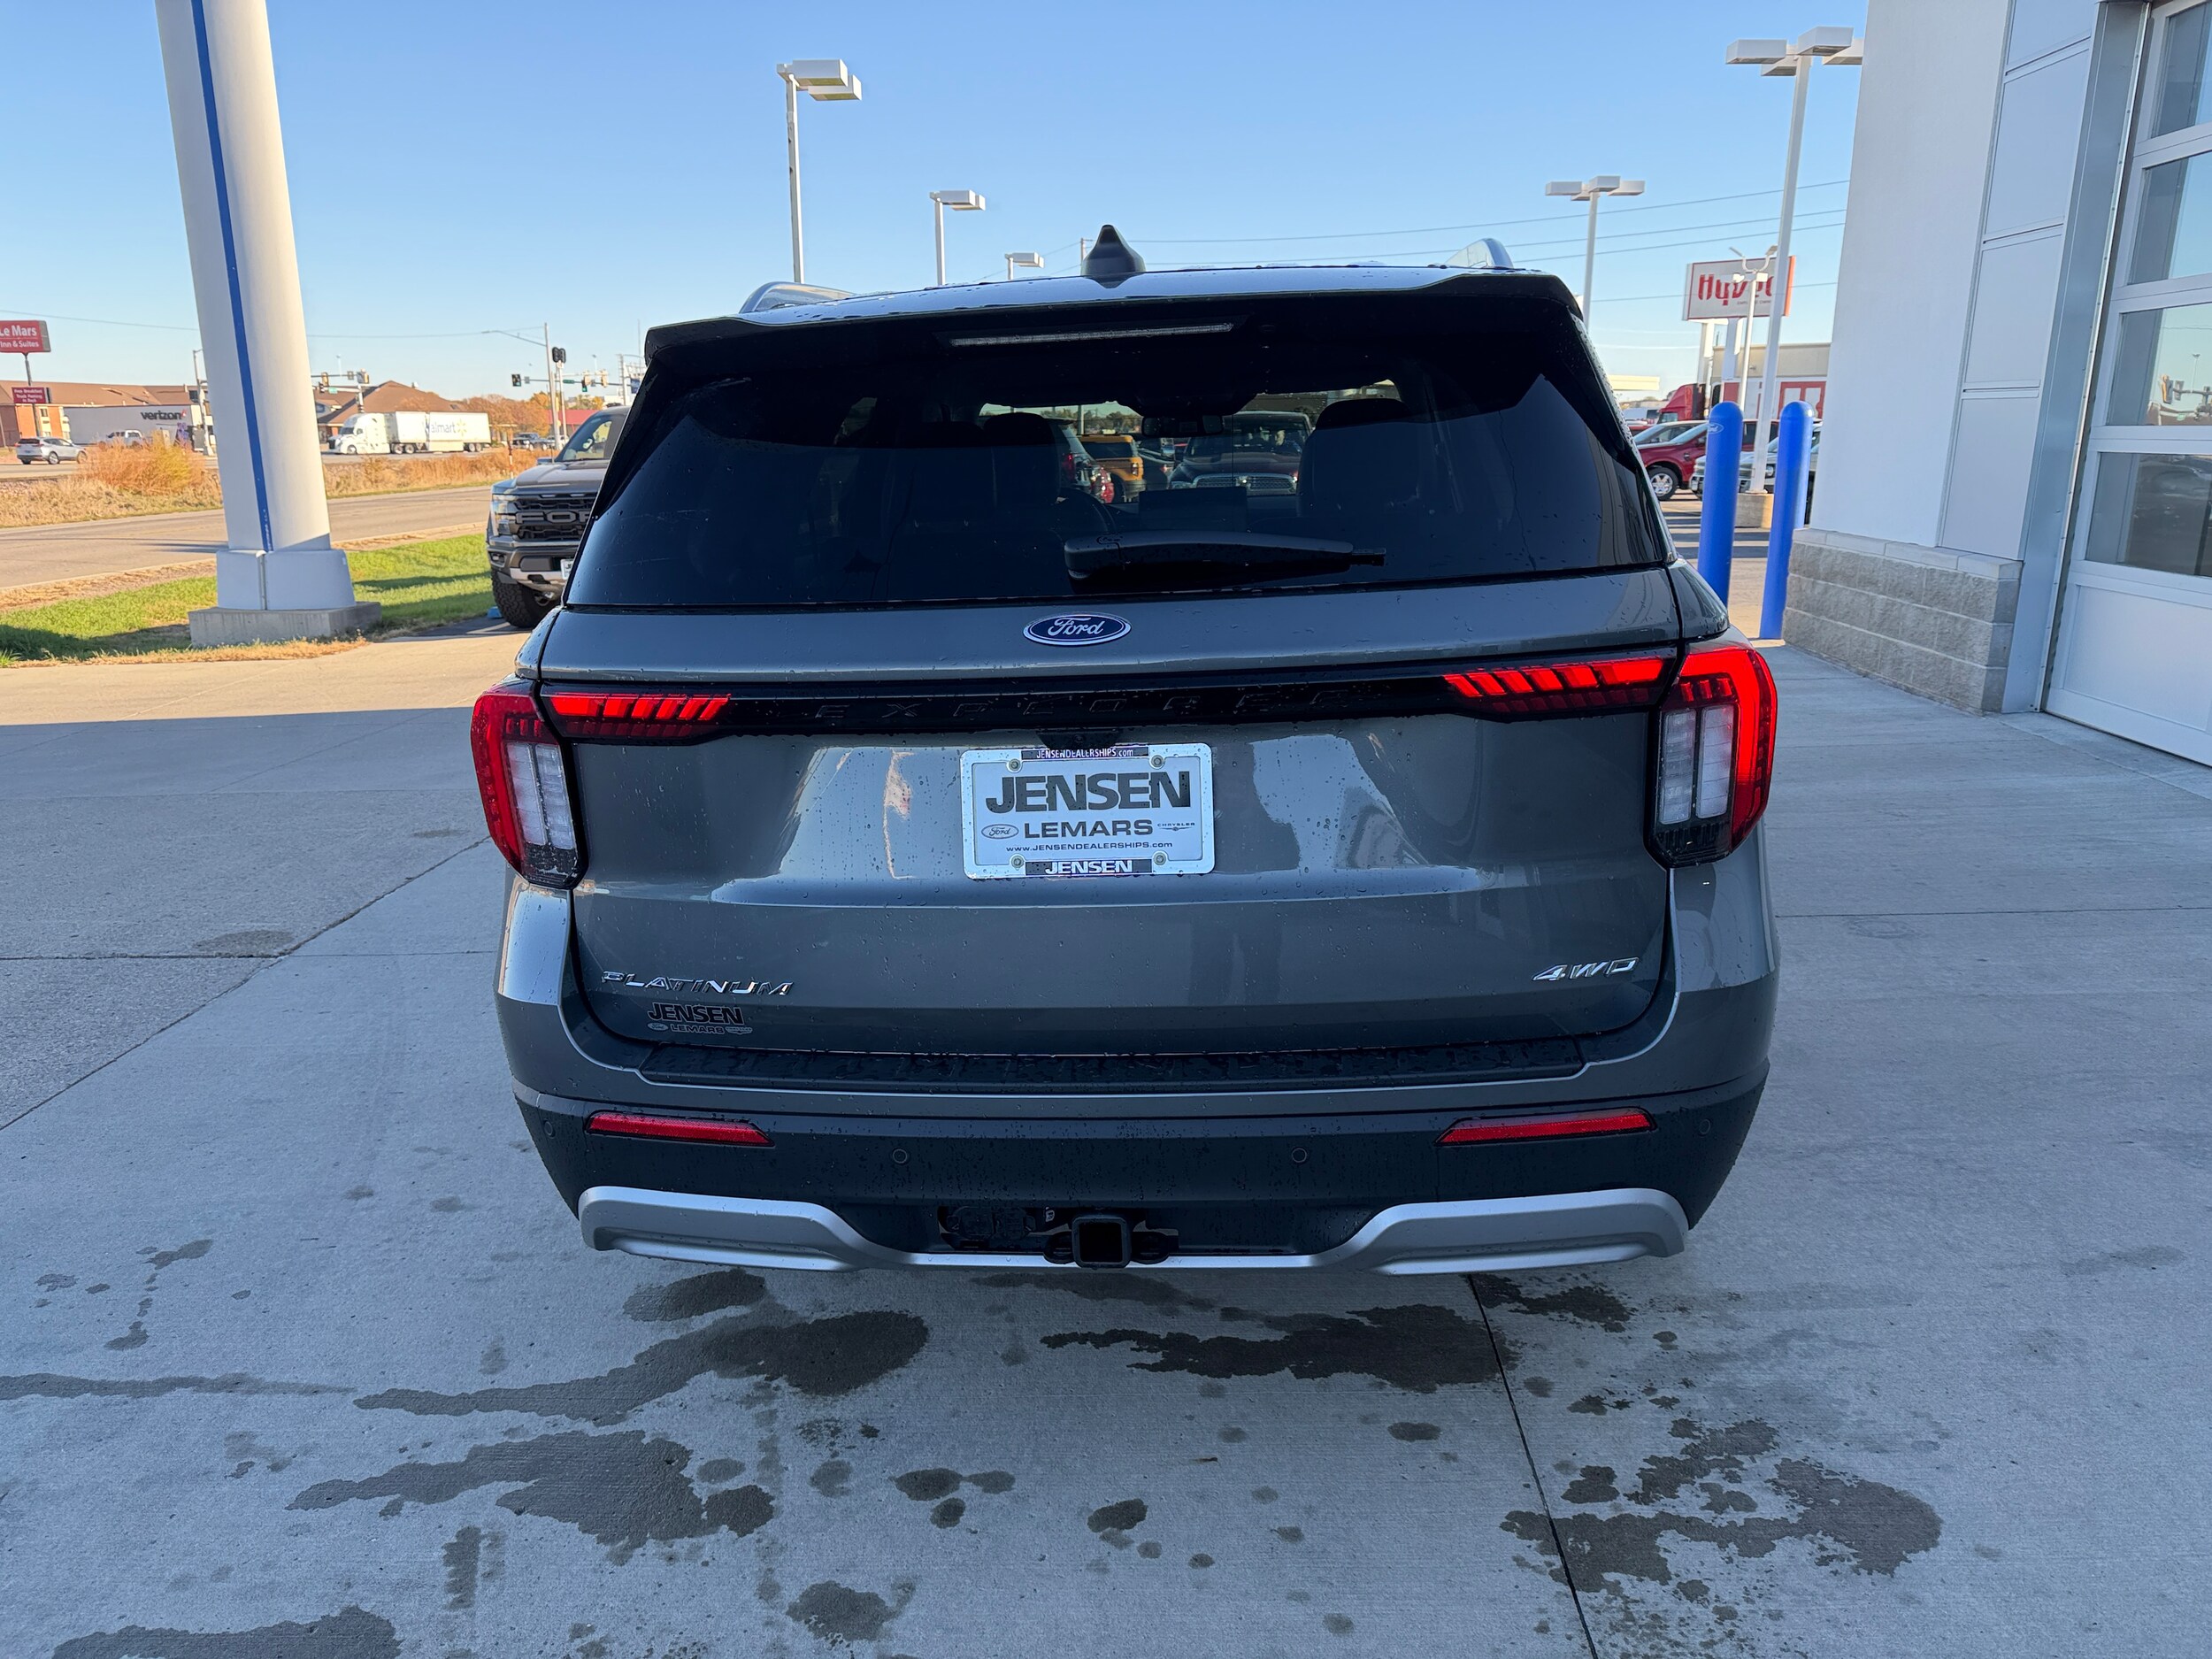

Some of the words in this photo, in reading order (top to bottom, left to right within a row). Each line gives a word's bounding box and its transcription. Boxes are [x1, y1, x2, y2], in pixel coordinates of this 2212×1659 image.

[11, 325, 37, 336] Mars
[140, 410, 182, 420] verizon
[1048, 617, 1106, 636] Ford
[814, 689, 1350, 718] EXPLORER
[1036, 747, 1134, 759] JENSENDEALERSHIPS.com
[985, 771, 1192, 814] JENSEN
[1024, 819, 1154, 839] LEMARS
[1005, 841, 1173, 852] www.JENSENDEALERSHIPS.com
[1044, 859, 1133, 875] JENSEN
[1532, 957, 1639, 981] 4WD
[602, 971, 794, 995] PLATINUM
[647, 1002, 745, 1025] JENSEN
